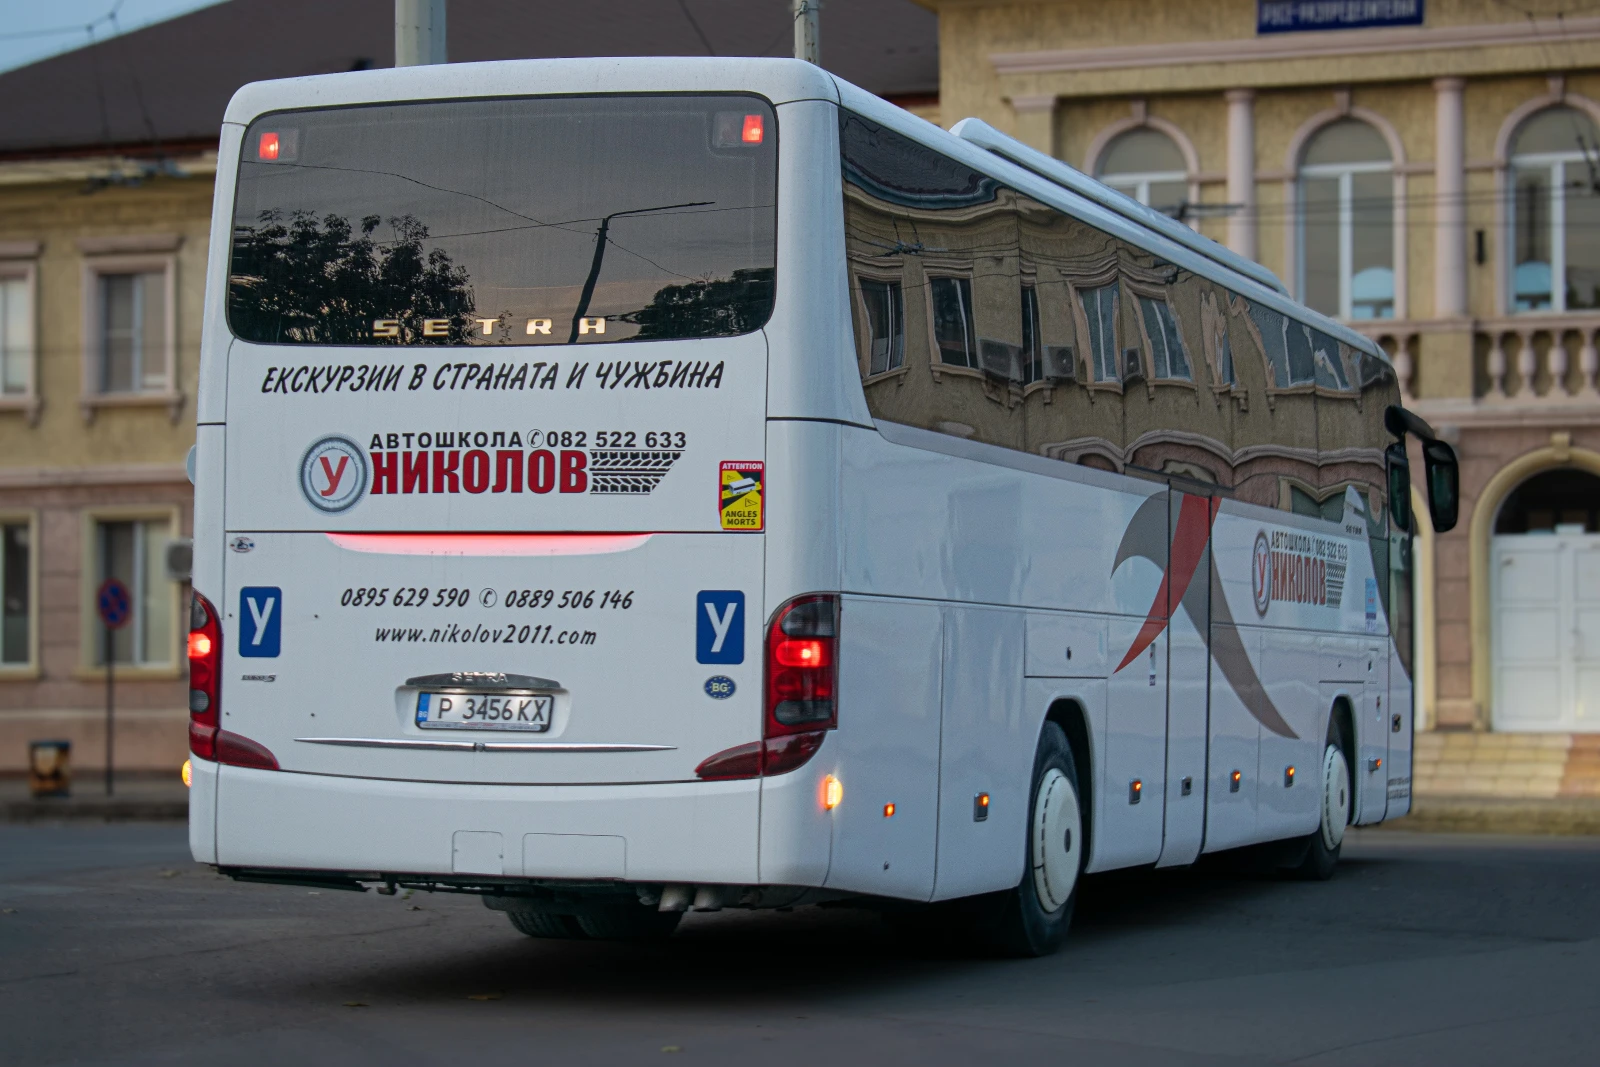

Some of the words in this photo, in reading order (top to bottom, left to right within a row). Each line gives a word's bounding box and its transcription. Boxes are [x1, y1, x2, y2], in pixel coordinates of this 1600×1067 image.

[372, 317, 606, 338] SETRA
[261, 364, 404, 394] ЕКСКУРЗИИ
[408, 363, 427, 390] В
[433, 362, 559, 391] СТРАНАТА
[565, 361, 589, 389] И
[595, 360, 724, 390] ЧУЖБИНА
[369, 431, 523, 449] АВТОШКОЛА
[546, 431, 587, 447] 082
[595, 431, 636, 448] 522
[645, 431, 686, 448] 633
[370, 449, 588, 494] НИКОЛОВ
[1271, 530, 1311, 555] АВТОШКОЛА
[1271, 551, 1326, 606] НИКОЛОВ
[341, 587, 389, 606] 0895
[393, 587, 429, 607] 629
[433, 588, 470, 607] 590
[505, 589, 554, 608] 0889
[558, 590, 595, 609] 506
[600, 590, 634, 609] 146
[375, 623, 597, 645] www.nikolov2011.com
[712, 683, 729, 692] BG
[418, 710, 428, 718] BG
[437, 698, 452, 719] P
[463, 698, 513, 720] 3456
[517, 700, 547, 722] KX
